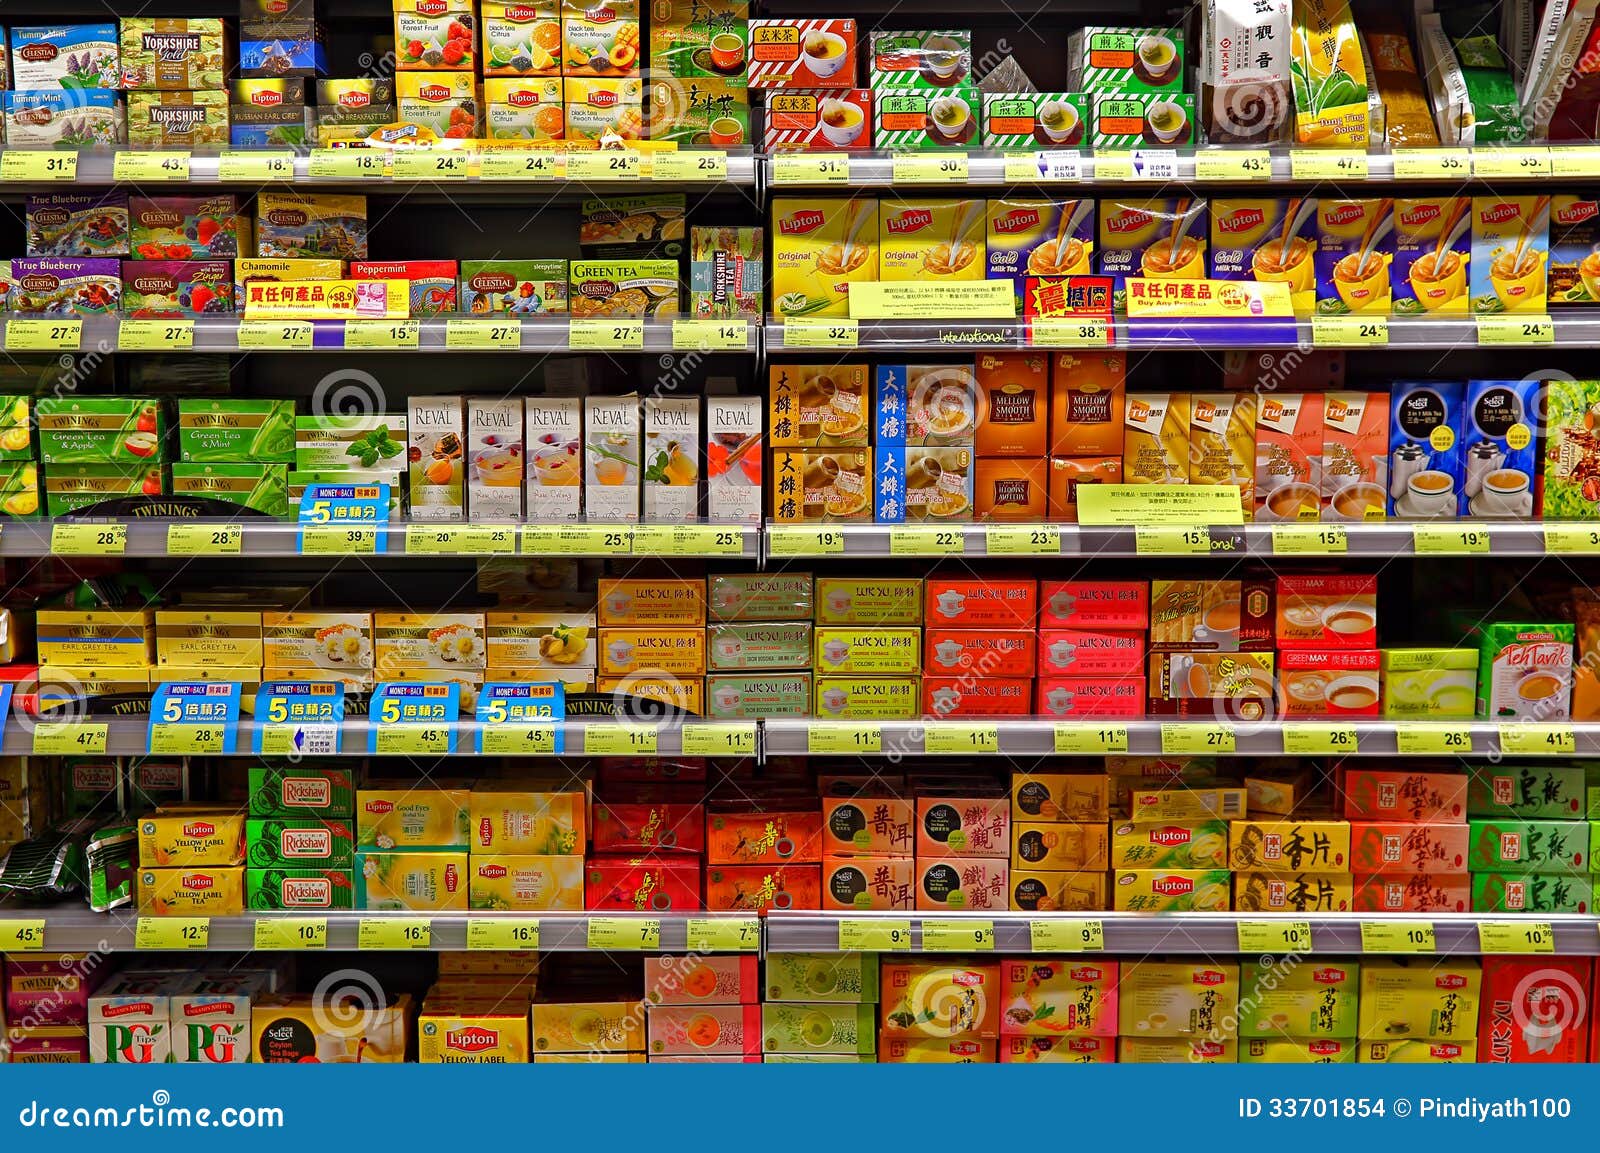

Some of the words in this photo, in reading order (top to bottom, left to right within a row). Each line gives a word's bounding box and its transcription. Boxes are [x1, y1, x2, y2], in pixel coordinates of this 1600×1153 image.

[418, 1, 446, 11] Lipton
[507, 8, 534, 18] Lipton
[760, 28, 794, 42] 玄米茶
[144, 35, 200, 49] YORKSHIRE
[1099, 37, 1126, 49] 煎茶
[158, 48, 191, 62] Gold
[11, 94, 41, 104] Tummy
[42, 93, 61, 102] Mint
[253, 94, 282, 104] Lipton
[421, 88, 450, 98] Lipton
[340, 94, 369, 105] Lipton
[777, 97, 811, 110] 玄米茶
[890, 97, 918, 110] 煎茶
[151, 108, 205, 122] YORKSHIRE
[264, 112, 280, 120] EARL
[282, 112, 298, 120] GREY
[1319, 117, 1343, 127] Tung
[1344, 113, 1365, 123] Ting
[1333, 124, 1365, 134] Oolong
[1350, 134, 1365, 142] Tea
[32, 196, 50, 204] True
[52, 196, 91, 204] Blueberry
[265, 195, 316, 205] Chamomile
[783, 214, 822, 230] Lipton
[890, 213, 929, 230] Lipton
[997, 213, 1036, 230] Lipton
[1221, 212, 1260, 230] Lipton
[1327, 209, 1362, 224] Lipton
[778, 252, 812, 261] Original
[885, 251, 918, 260] Original
[19, 261, 38, 270] True
[40, 261, 82, 271] Blueberry
[241, 261, 291, 271] Chamomile
[357, 264, 407, 275] Peppermint
[574, 265, 614, 279] GREEN
[616, 267, 637, 277] TEA
[714, 252, 726, 302] YORKSHIRE
[726, 266, 735, 286] TEA
[250, 286, 325, 302] 買任何產品
[1131, 282, 1212, 299] 買任何產品
[1040, 284, 1107, 315] 震撼價
[939, 329, 1006, 344] International
[773, 370, 793, 439] 大排檔
[881, 369, 900, 439] 大排檔
[995, 396, 1030, 406] MELLOW
[1073, 395, 1108, 406] MELLOW
[1407, 399, 1428, 408] Select
[415, 407, 453, 425] REVAL
[533, 407, 571, 426] REVAL
[592, 407, 630, 425] REVAL
[653, 407, 690, 426] REVAL
[715, 407, 753, 426] REVAL
[994, 406, 1029, 415] SMOOTH
[1072, 406, 1108, 415] SMOOTH
[52, 417, 101, 429] TWININGS
[191, 415, 240, 428] TWININGS
[476, 410, 513, 427] REVAL
[800, 412, 819, 423] Milk
[820, 412, 838, 423] Tea
[52, 431, 84, 441] Green
[85, 431, 105, 441] Tea
[190, 431, 220, 440] Green
[222, 430, 241, 440] Tea
[58, 479, 107, 492] TWININGS
[131, 502, 201, 519] TWININGS
[311, 500, 332, 524] 5
[333, 505, 377, 519] 倍積分
[68, 625, 113, 637] TWININGS
[637, 638, 656, 648] LUK
[658, 638, 672, 648] YU
[853, 637, 873, 647] LUK
[874, 638, 887, 647] YU
[1331, 654, 1376, 665] 炭香紅奶茶
[1505, 644, 1529, 665] Teh
[1531, 645, 1568, 667] Tarik
[163, 698, 182, 722] 5
[185, 703, 228, 715] 倍積分
[268, 698, 288, 722] 5
[290, 703, 333, 716] 倍積分
[381, 699, 401, 723] 5
[286, 786, 326, 801] Rickshaw
[367, 803, 393, 812] Lipton
[397, 804, 414, 812] Good
[414, 805, 430, 813] Eyes
[185, 826, 214, 837] Lipton
[867, 804, 913, 850] 普洱
[176, 838, 202, 848] YELLOW
[203, 838, 225, 847] LABEL
[285, 835, 327, 851] Rickshaw
[1152, 831, 1189, 843] Lipton
[1283, 826, 1332, 870] 香片
[479, 866, 506, 877] Lipton
[512, 869, 543, 879] Cleansing
[184, 878, 212, 888] Lipton
[868, 865, 914, 910] 普洱
[1155, 881, 1191, 892] Lipton
[174, 890, 201, 899] YELLOW
[202, 890, 223, 899] LABEL
[285, 884, 326, 900] Rickshaw
[1074, 971, 1100, 980] 立頓
[135, 1034, 157, 1044] Tips
[216, 1034, 238, 1044] Tips
[268, 1029, 294, 1040] Select
[449, 1031, 495, 1048] Lipton
[104, 1023, 154, 1063] PG
[187, 1023, 235, 1063] PG
[269, 1041, 293, 1050] Ceylon
[282, 1050, 299, 1059] Bags
